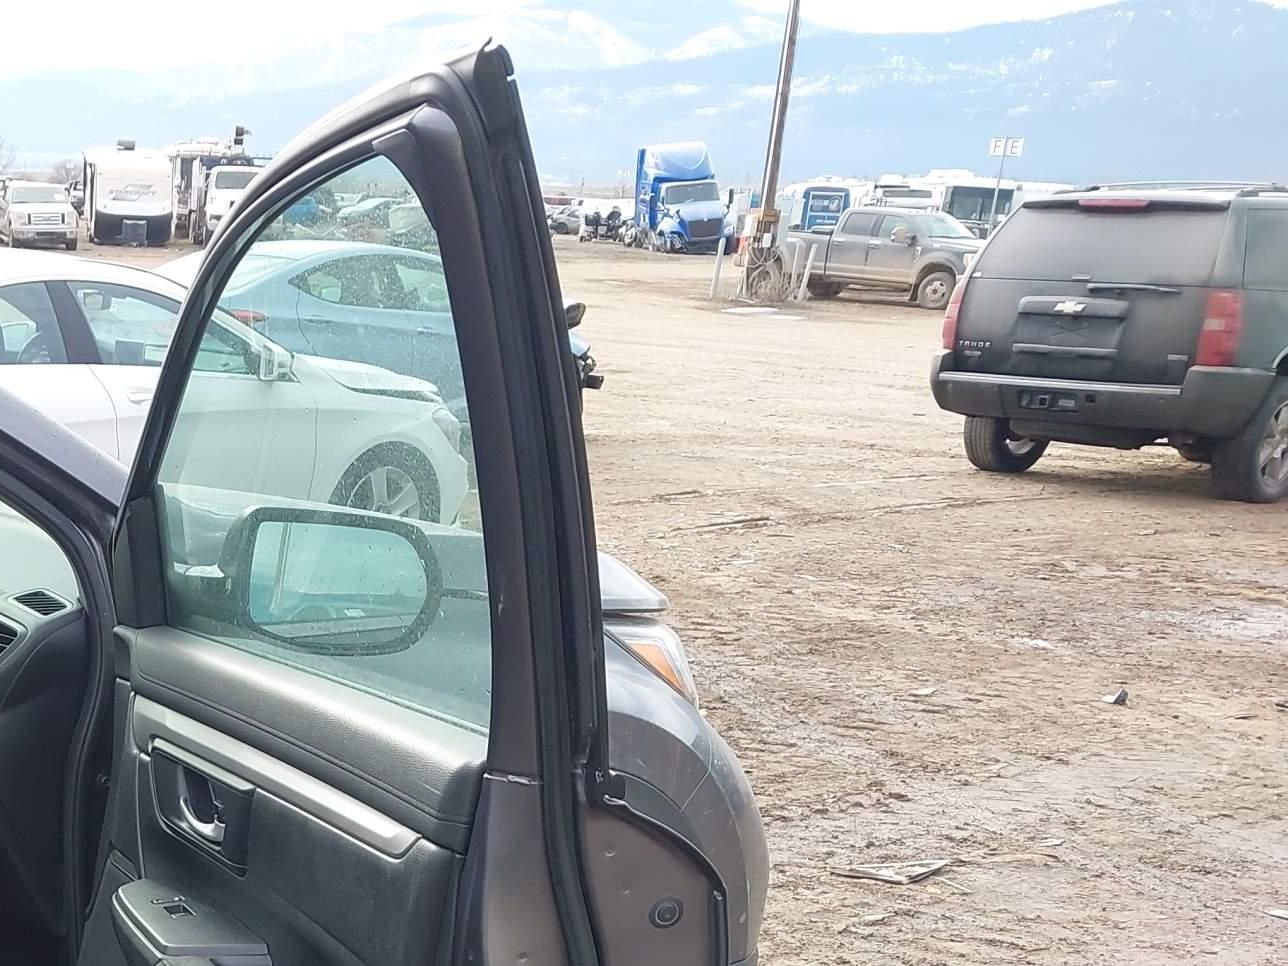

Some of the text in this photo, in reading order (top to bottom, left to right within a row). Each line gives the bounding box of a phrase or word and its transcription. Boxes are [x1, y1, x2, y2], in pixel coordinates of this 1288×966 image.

[993, 139, 1021, 154] F E
[958, 340, 991, 348] TAHOE
